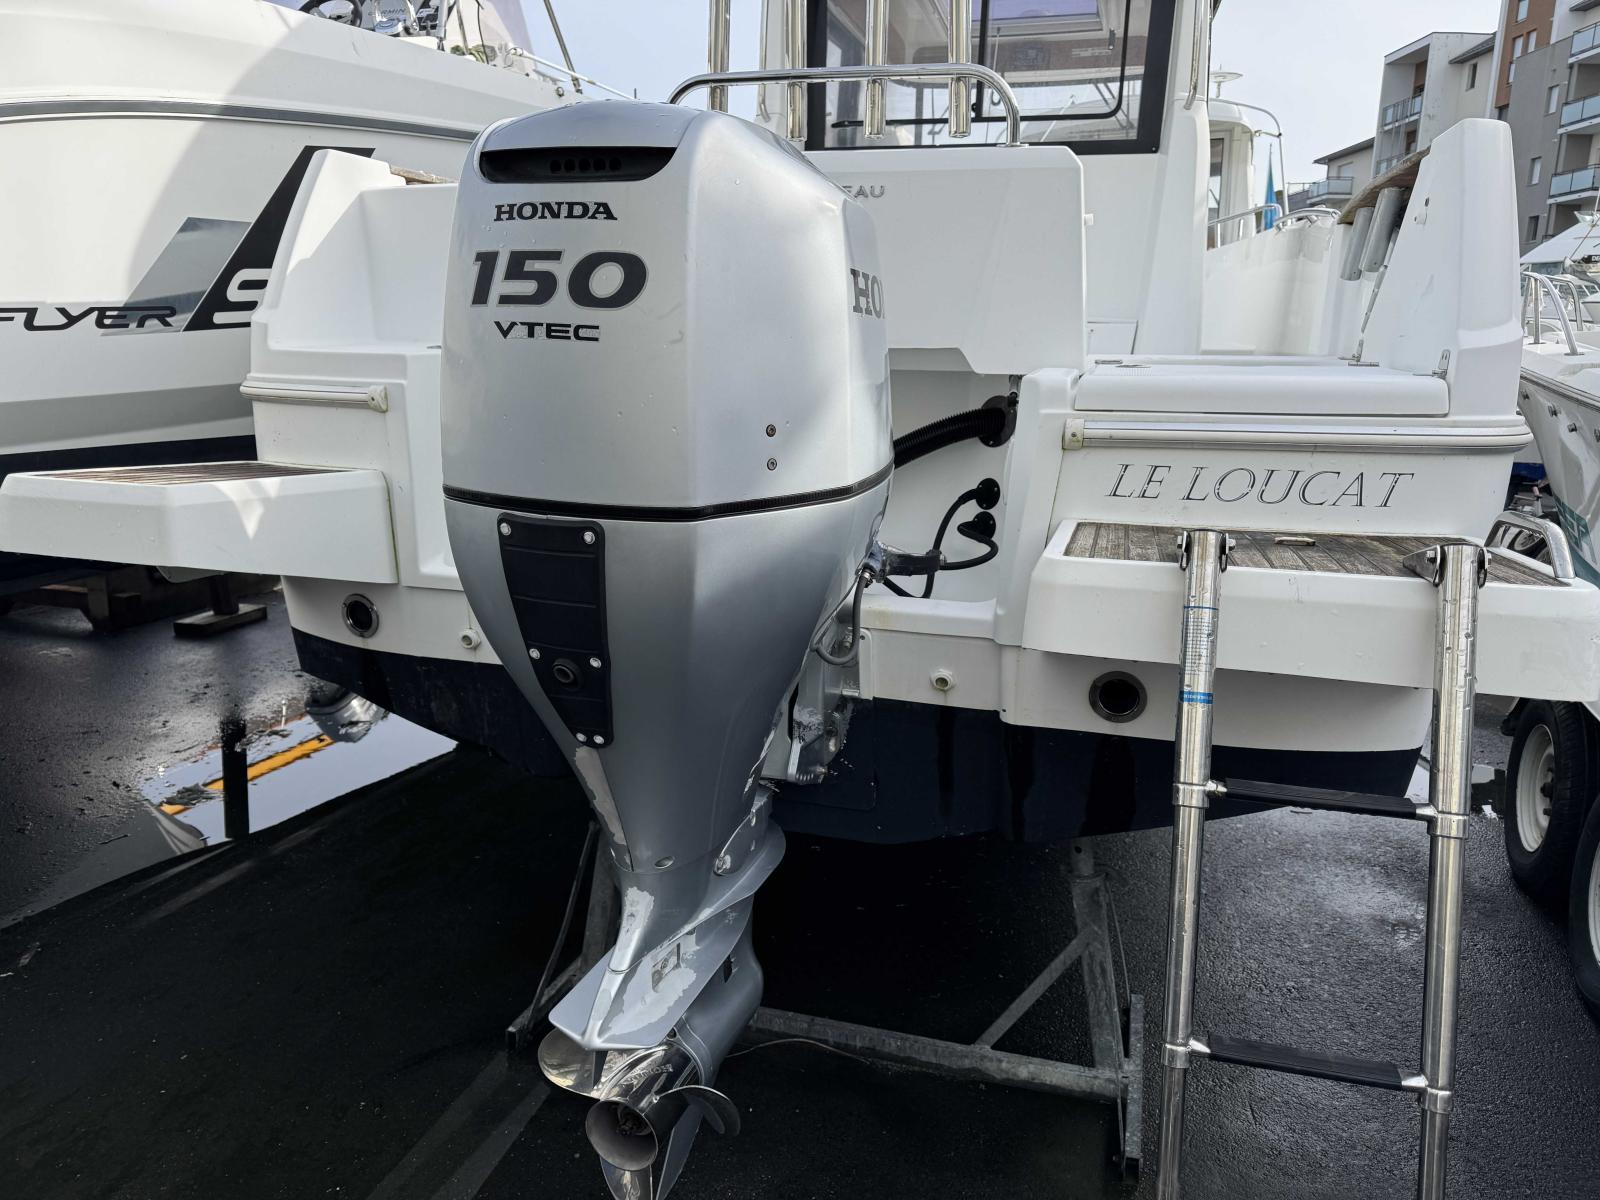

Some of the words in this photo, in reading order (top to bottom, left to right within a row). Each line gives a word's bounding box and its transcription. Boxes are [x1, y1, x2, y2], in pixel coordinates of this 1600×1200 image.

[493, 201, 618, 222] HONDA
[470, 249, 650, 311] 150
[850, 268, 885, 319] HO
[493, 321, 600, 342] VTEC
[1104, 463, 1172, 499] LE
[1178, 466, 1415, 508] LOUCAT
